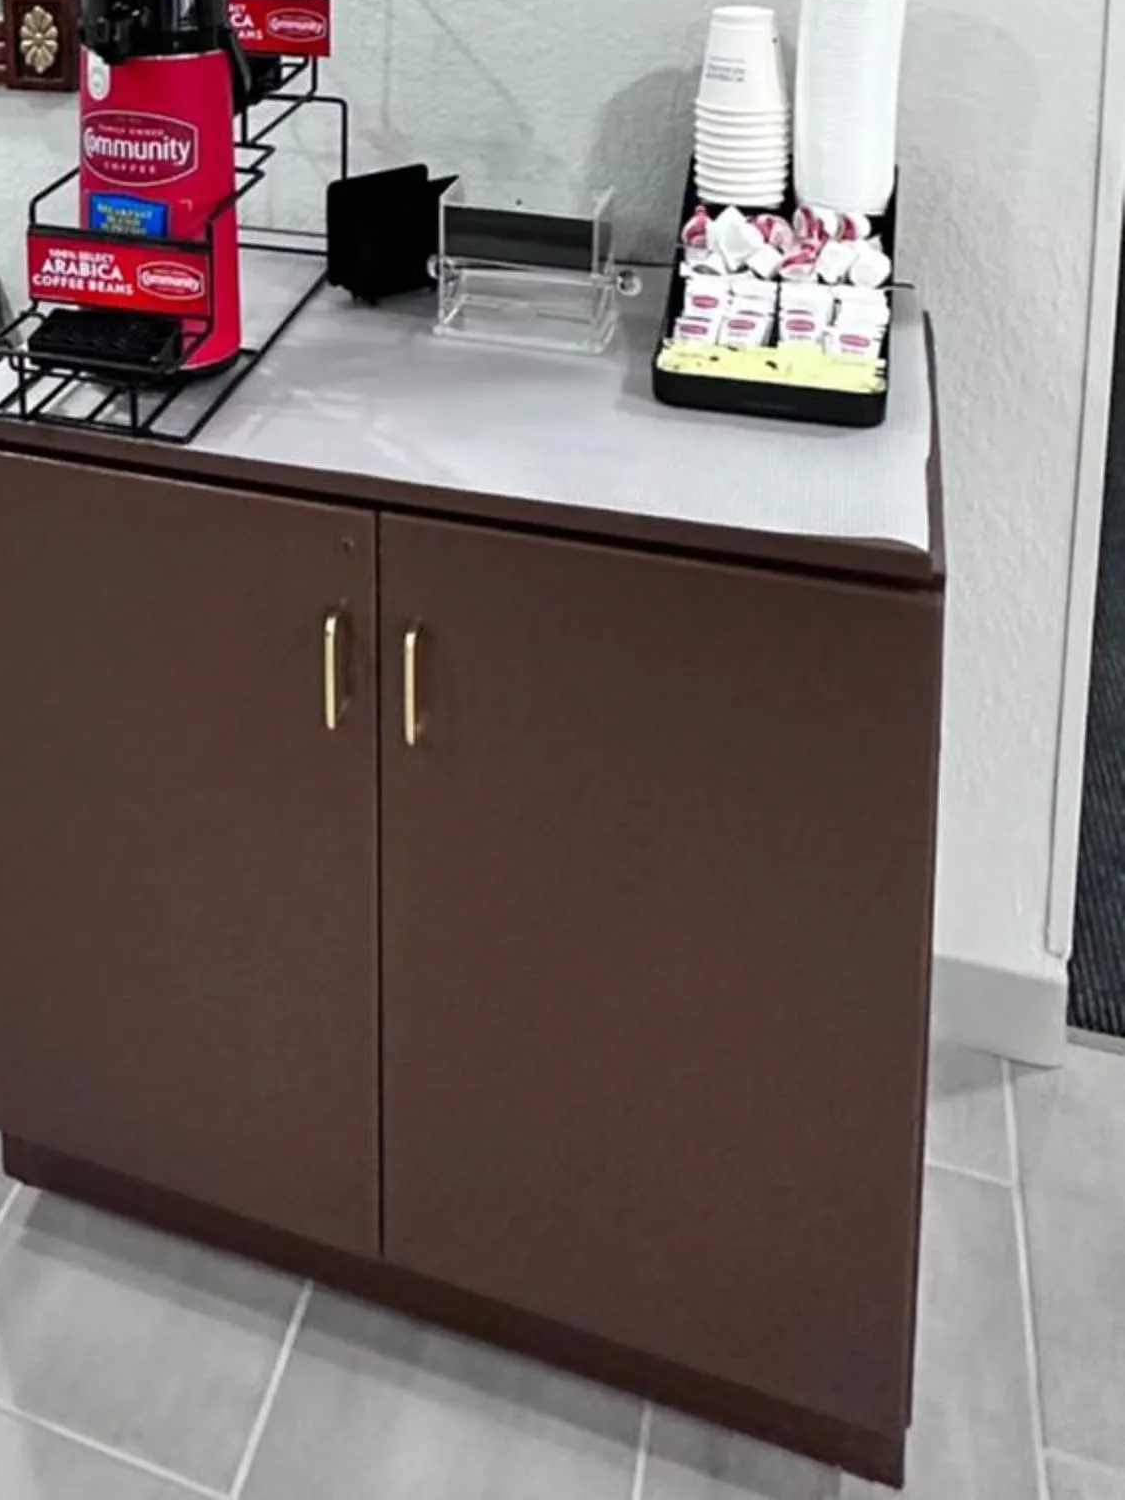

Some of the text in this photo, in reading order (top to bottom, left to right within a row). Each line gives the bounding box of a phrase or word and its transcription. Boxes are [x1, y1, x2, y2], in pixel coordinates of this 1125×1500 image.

[82, 126, 192, 166] Community
[42, 258, 124, 282] ARABICA
[31, 273, 135, 296] COFFEE BEANS
